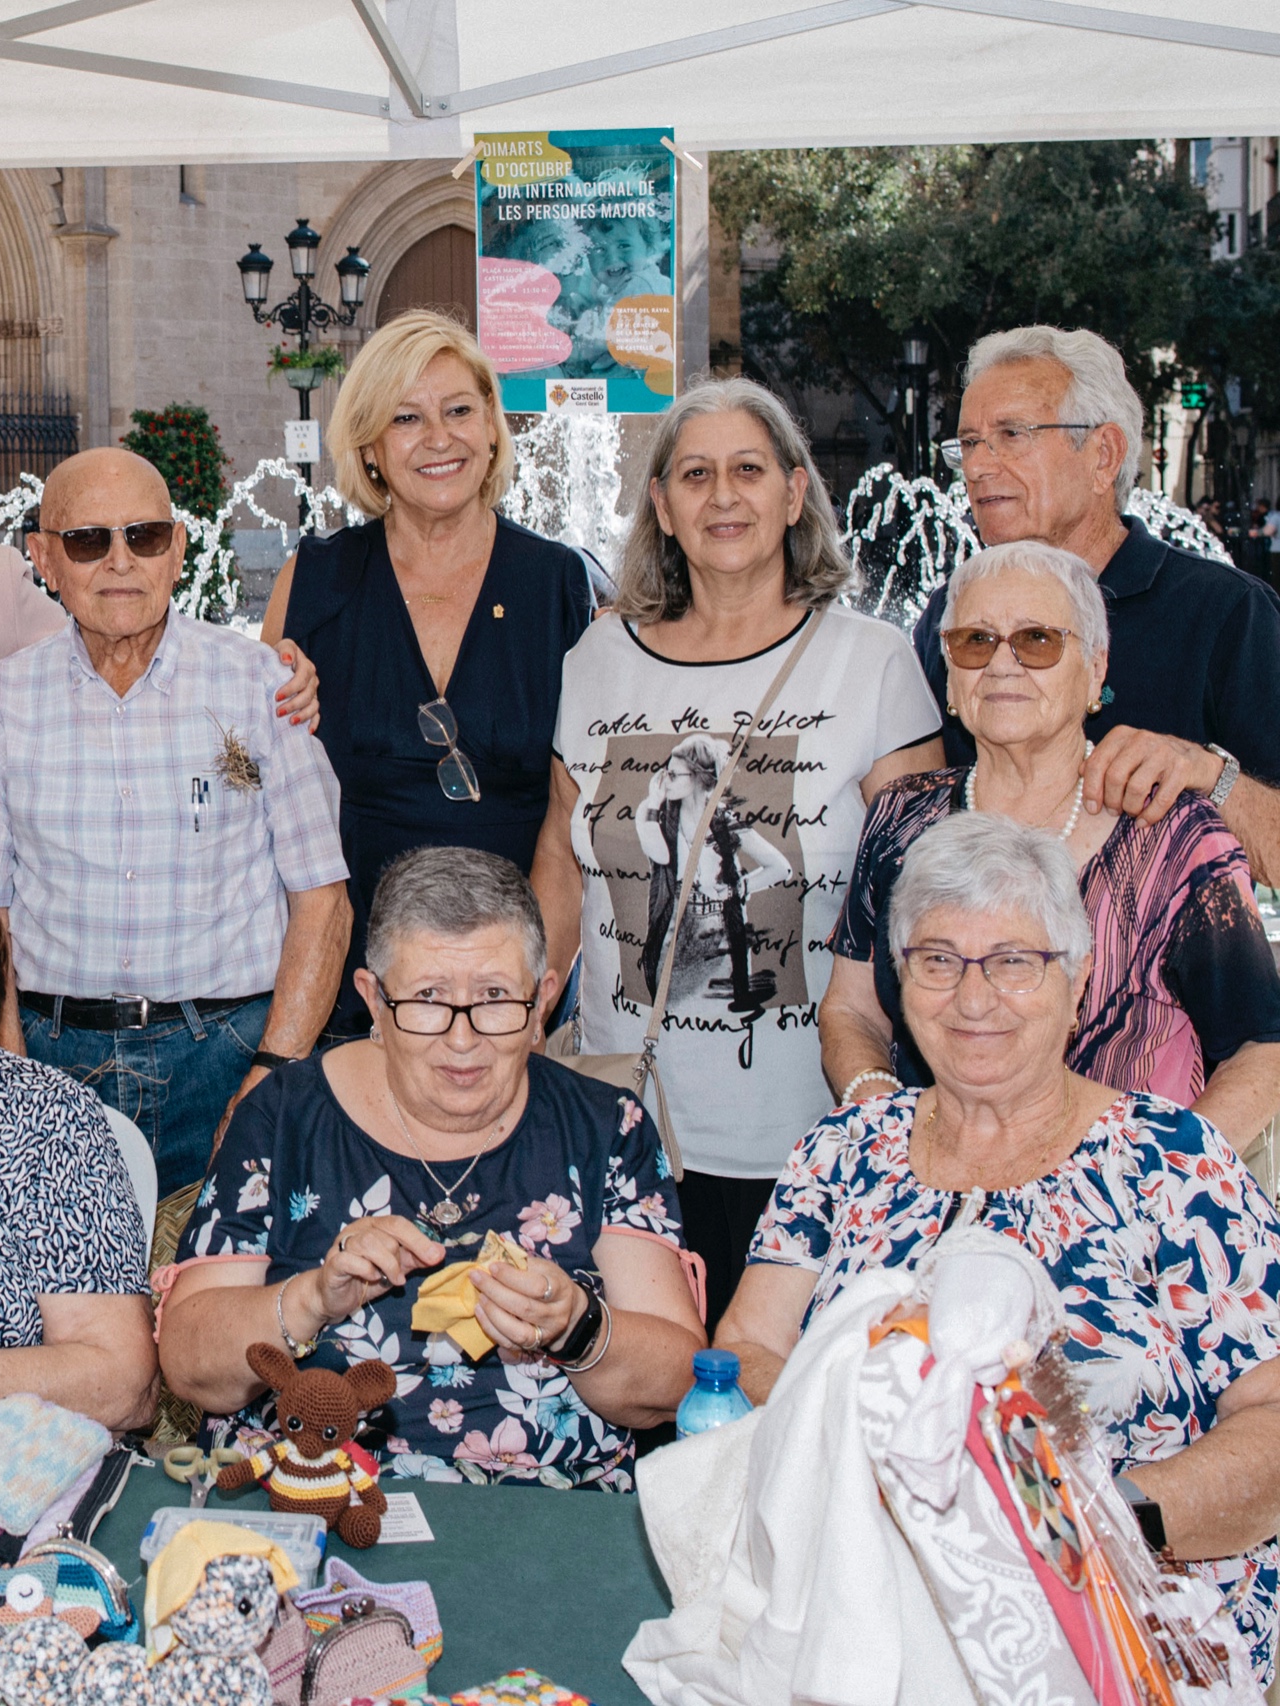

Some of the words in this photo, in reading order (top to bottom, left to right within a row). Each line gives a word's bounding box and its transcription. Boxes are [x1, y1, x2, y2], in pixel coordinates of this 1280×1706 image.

[483, 141, 543, 157] DIMARTS
[484, 163, 490, 178] 1
[496, 162, 571, 178] D'OCTUBRE
[498, 184, 521, 199] DIA
[525, 181, 633, 199] INTERNACIONAL
[639, 180, 655, 196] DE
[499, 205, 521, 221] LES
[527, 203, 596, 220] PERSONES
[601, 202, 655, 219] MAJORS
[570, 391, 604, 401] Castelló
[588, 712, 652, 736] catch
[671, 707, 710, 733] the
[747, 753, 827, 775] dream
[583, 794, 615, 847] of
[612, 974, 641, 1017] the
